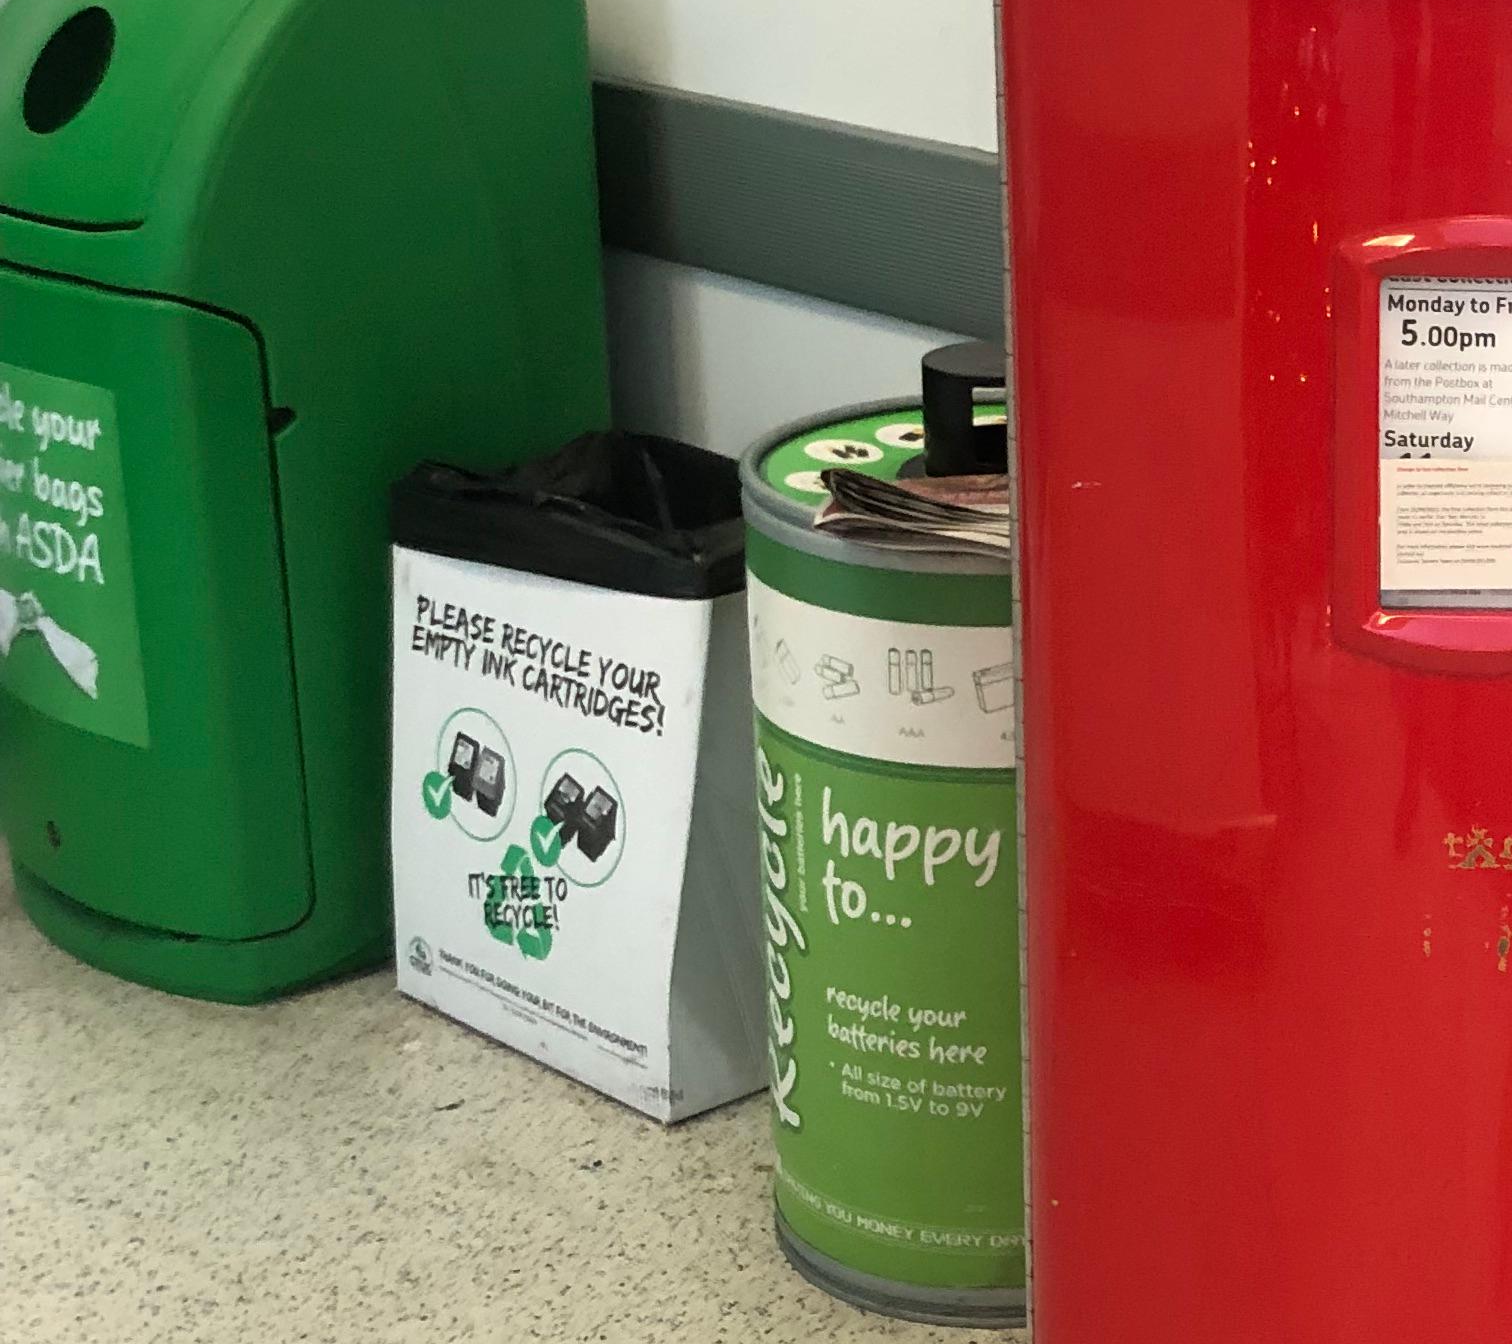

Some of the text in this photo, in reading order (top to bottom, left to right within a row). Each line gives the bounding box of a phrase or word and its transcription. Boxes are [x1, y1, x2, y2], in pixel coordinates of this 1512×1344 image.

[1387, 294, 1465, 316] Monday
[1470, 297, 1490, 314] to
[1401, 319, 1496, 351] 5.00pm
[1384, 375, 1411, 387] from
[1414, 376, 1432, 388] the
[1434, 376, 1479, 388] Postbox
[1423, 360, 1476, 372] collection
[1383, 392, 1460, 408] Southampton
[1463, 393, 1486, 406] Mail
[1429, 410, 1455, 424] Way
[32, 404, 102, 452] your
[1384, 429, 1474, 452] Saturday
[33, 456, 105, 527] bags
[16, 513, 105, 585] ASDA
[416, 594, 662, 706] PLEASE RECYCLE YOUR
[412, 624, 666, 737] EMPTY INK CARTRIDGES!
[821, 785, 1002, 888] happy
[544, 876, 568, 903] TO
[826, 985, 968, 1034] recycle your
[826, 1014, 988, 1065] batteries here
[842, 1061, 1007, 1103] All size of battery
[842, 1080, 881, 1105] from
[929, 1098, 950, 1117] to
